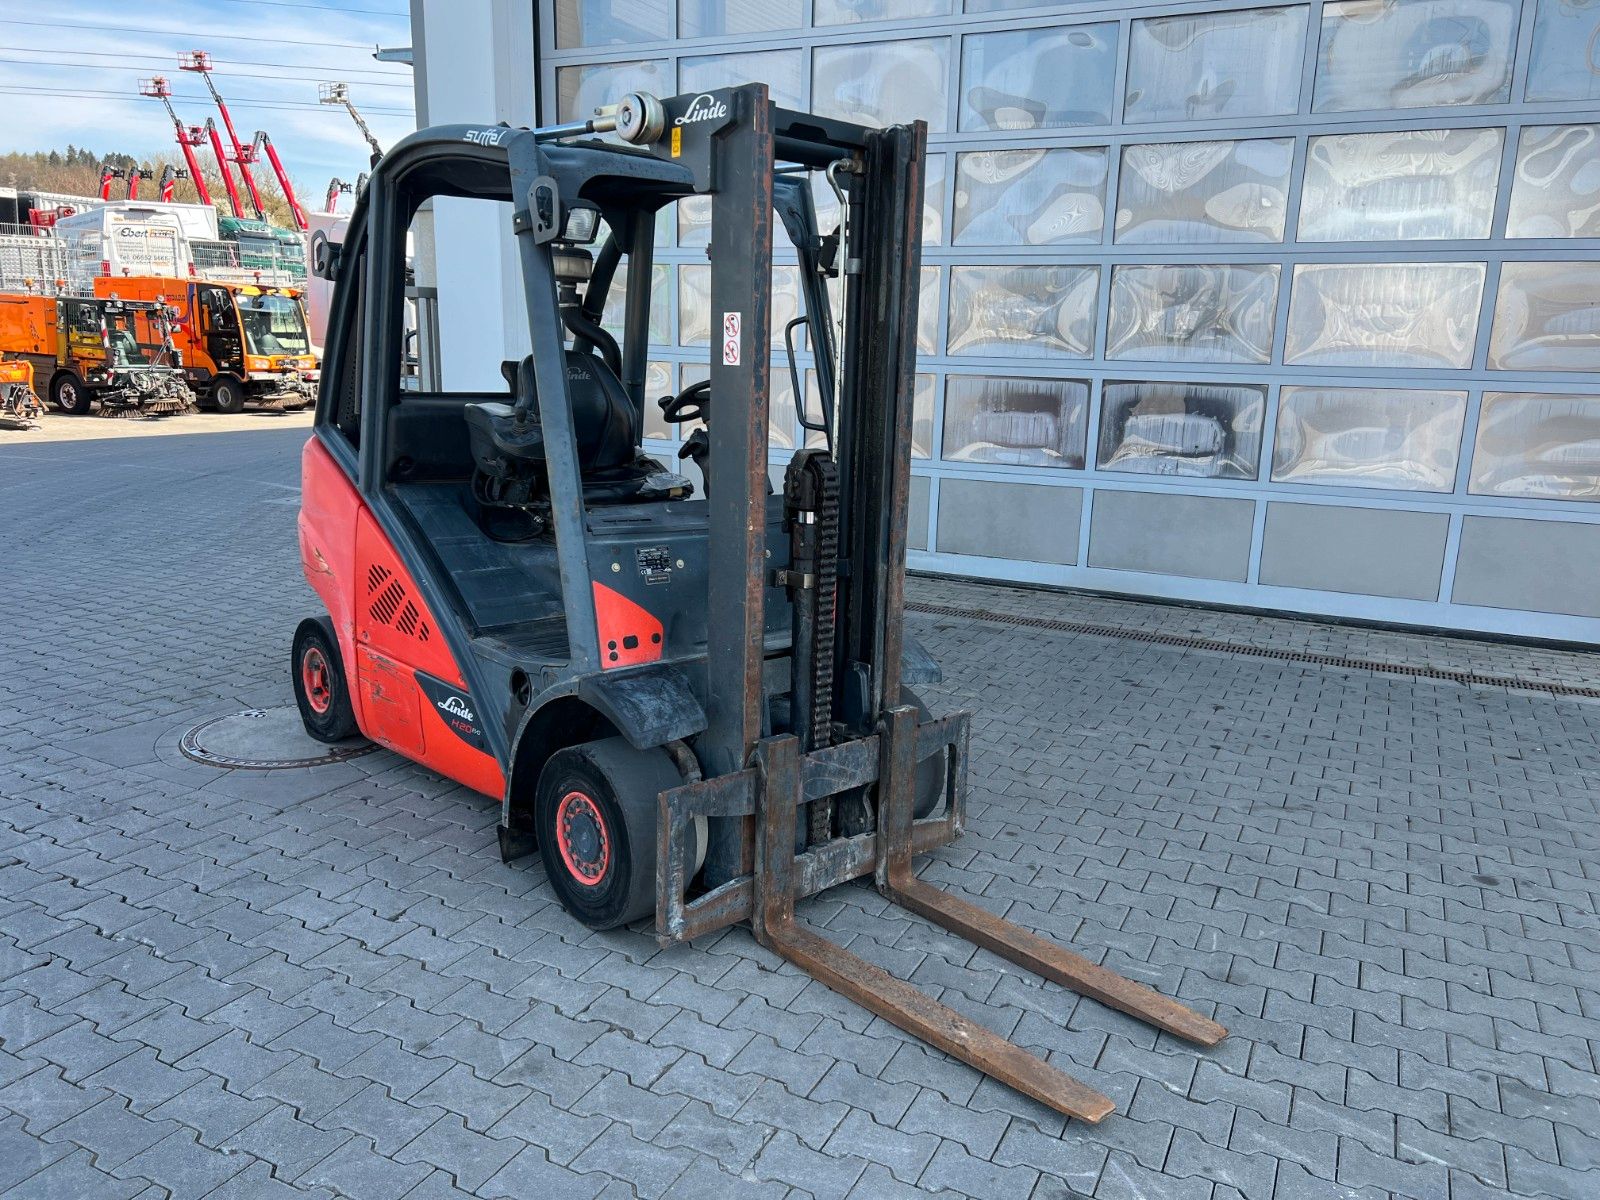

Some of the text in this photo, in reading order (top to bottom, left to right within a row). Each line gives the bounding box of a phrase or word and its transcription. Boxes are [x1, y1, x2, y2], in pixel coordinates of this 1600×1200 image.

[674, 94, 727, 125] Linde
[463, 129, 507, 147] suffel
[120, 227, 149, 238] Ebert
[437, 696, 474, 722] Linde
